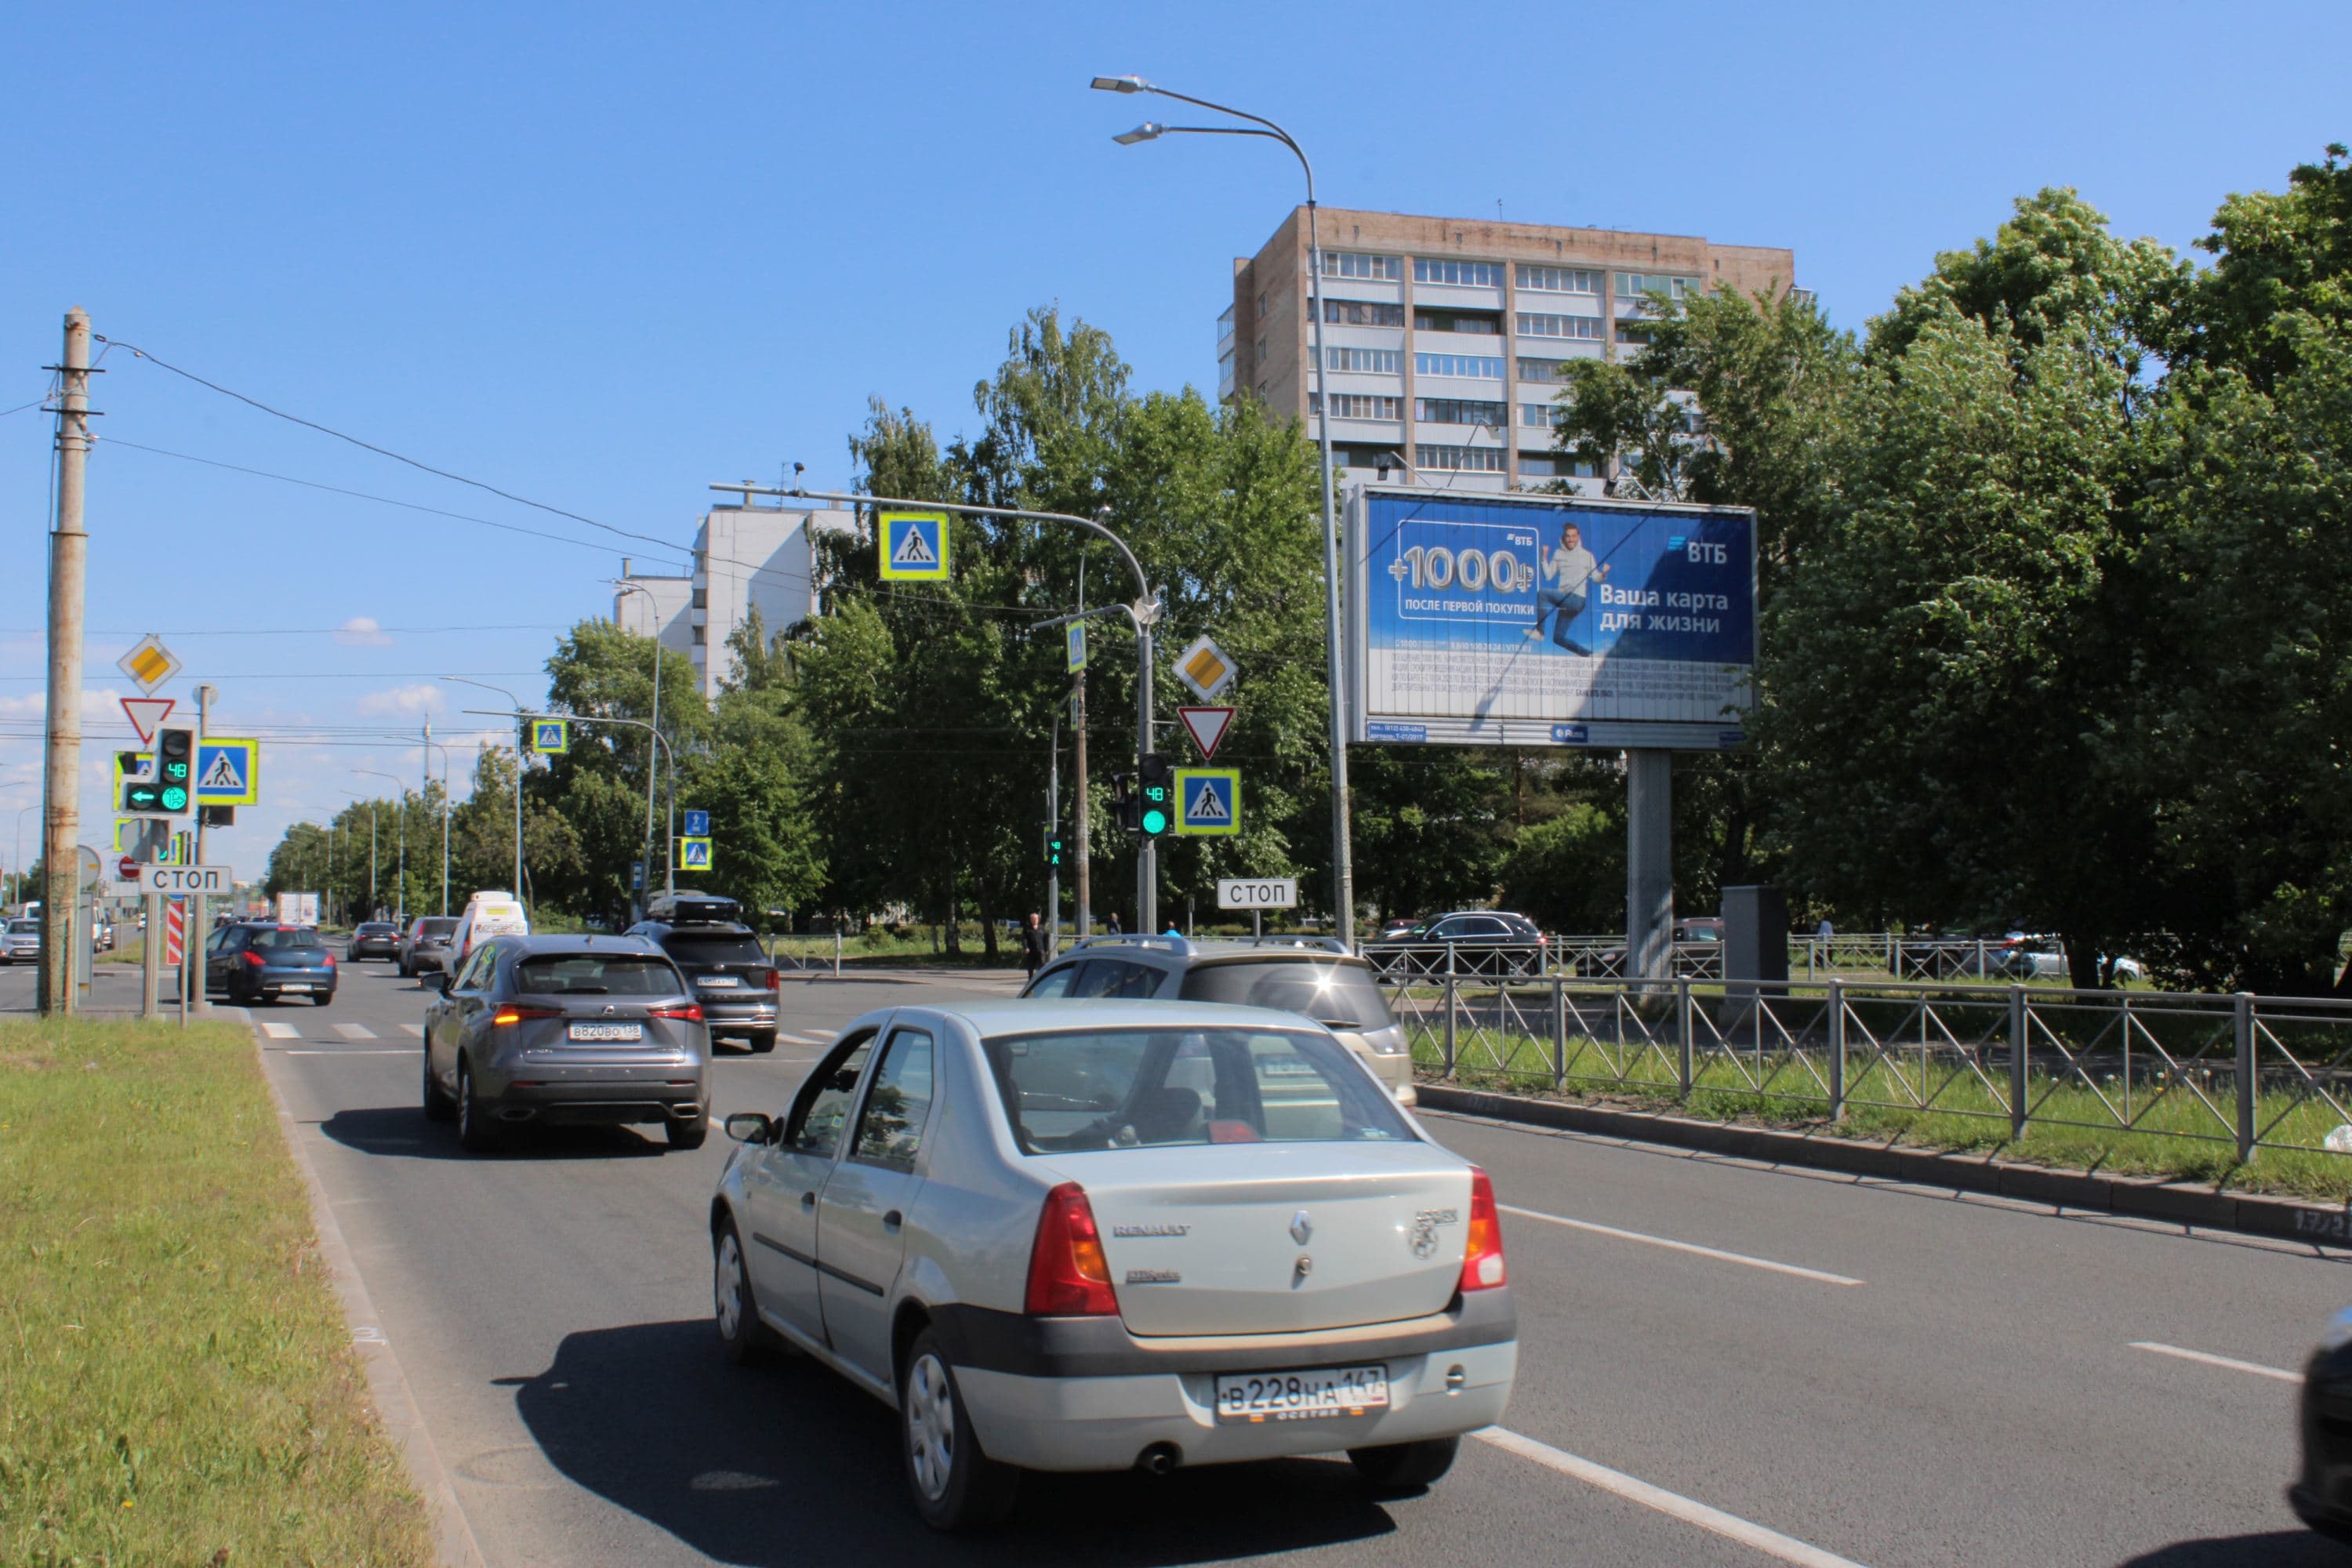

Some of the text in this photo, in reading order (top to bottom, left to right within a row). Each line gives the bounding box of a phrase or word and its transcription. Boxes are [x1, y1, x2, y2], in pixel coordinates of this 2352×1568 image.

[1515, 536, 1533, 546] ВТБ
[1688, 542, 1727, 564] ВТБ
[1405, 598, 1534, 615] ПОСЛЕ ПЕРВОЙ ПОКУПКИ
[1600, 583, 1728, 614] Ваша карта
[1600, 612, 1720, 633] для жизни
[169, 763, 187, 778] 48
[1146, 786, 1163, 801] 48
[153, 870, 218, 889] СТОП
[1230, 884, 1285, 903] СТОП
[1113, 1223, 1191, 1237] RENAULT
[1229, 1377, 1338, 1410] В228НА
